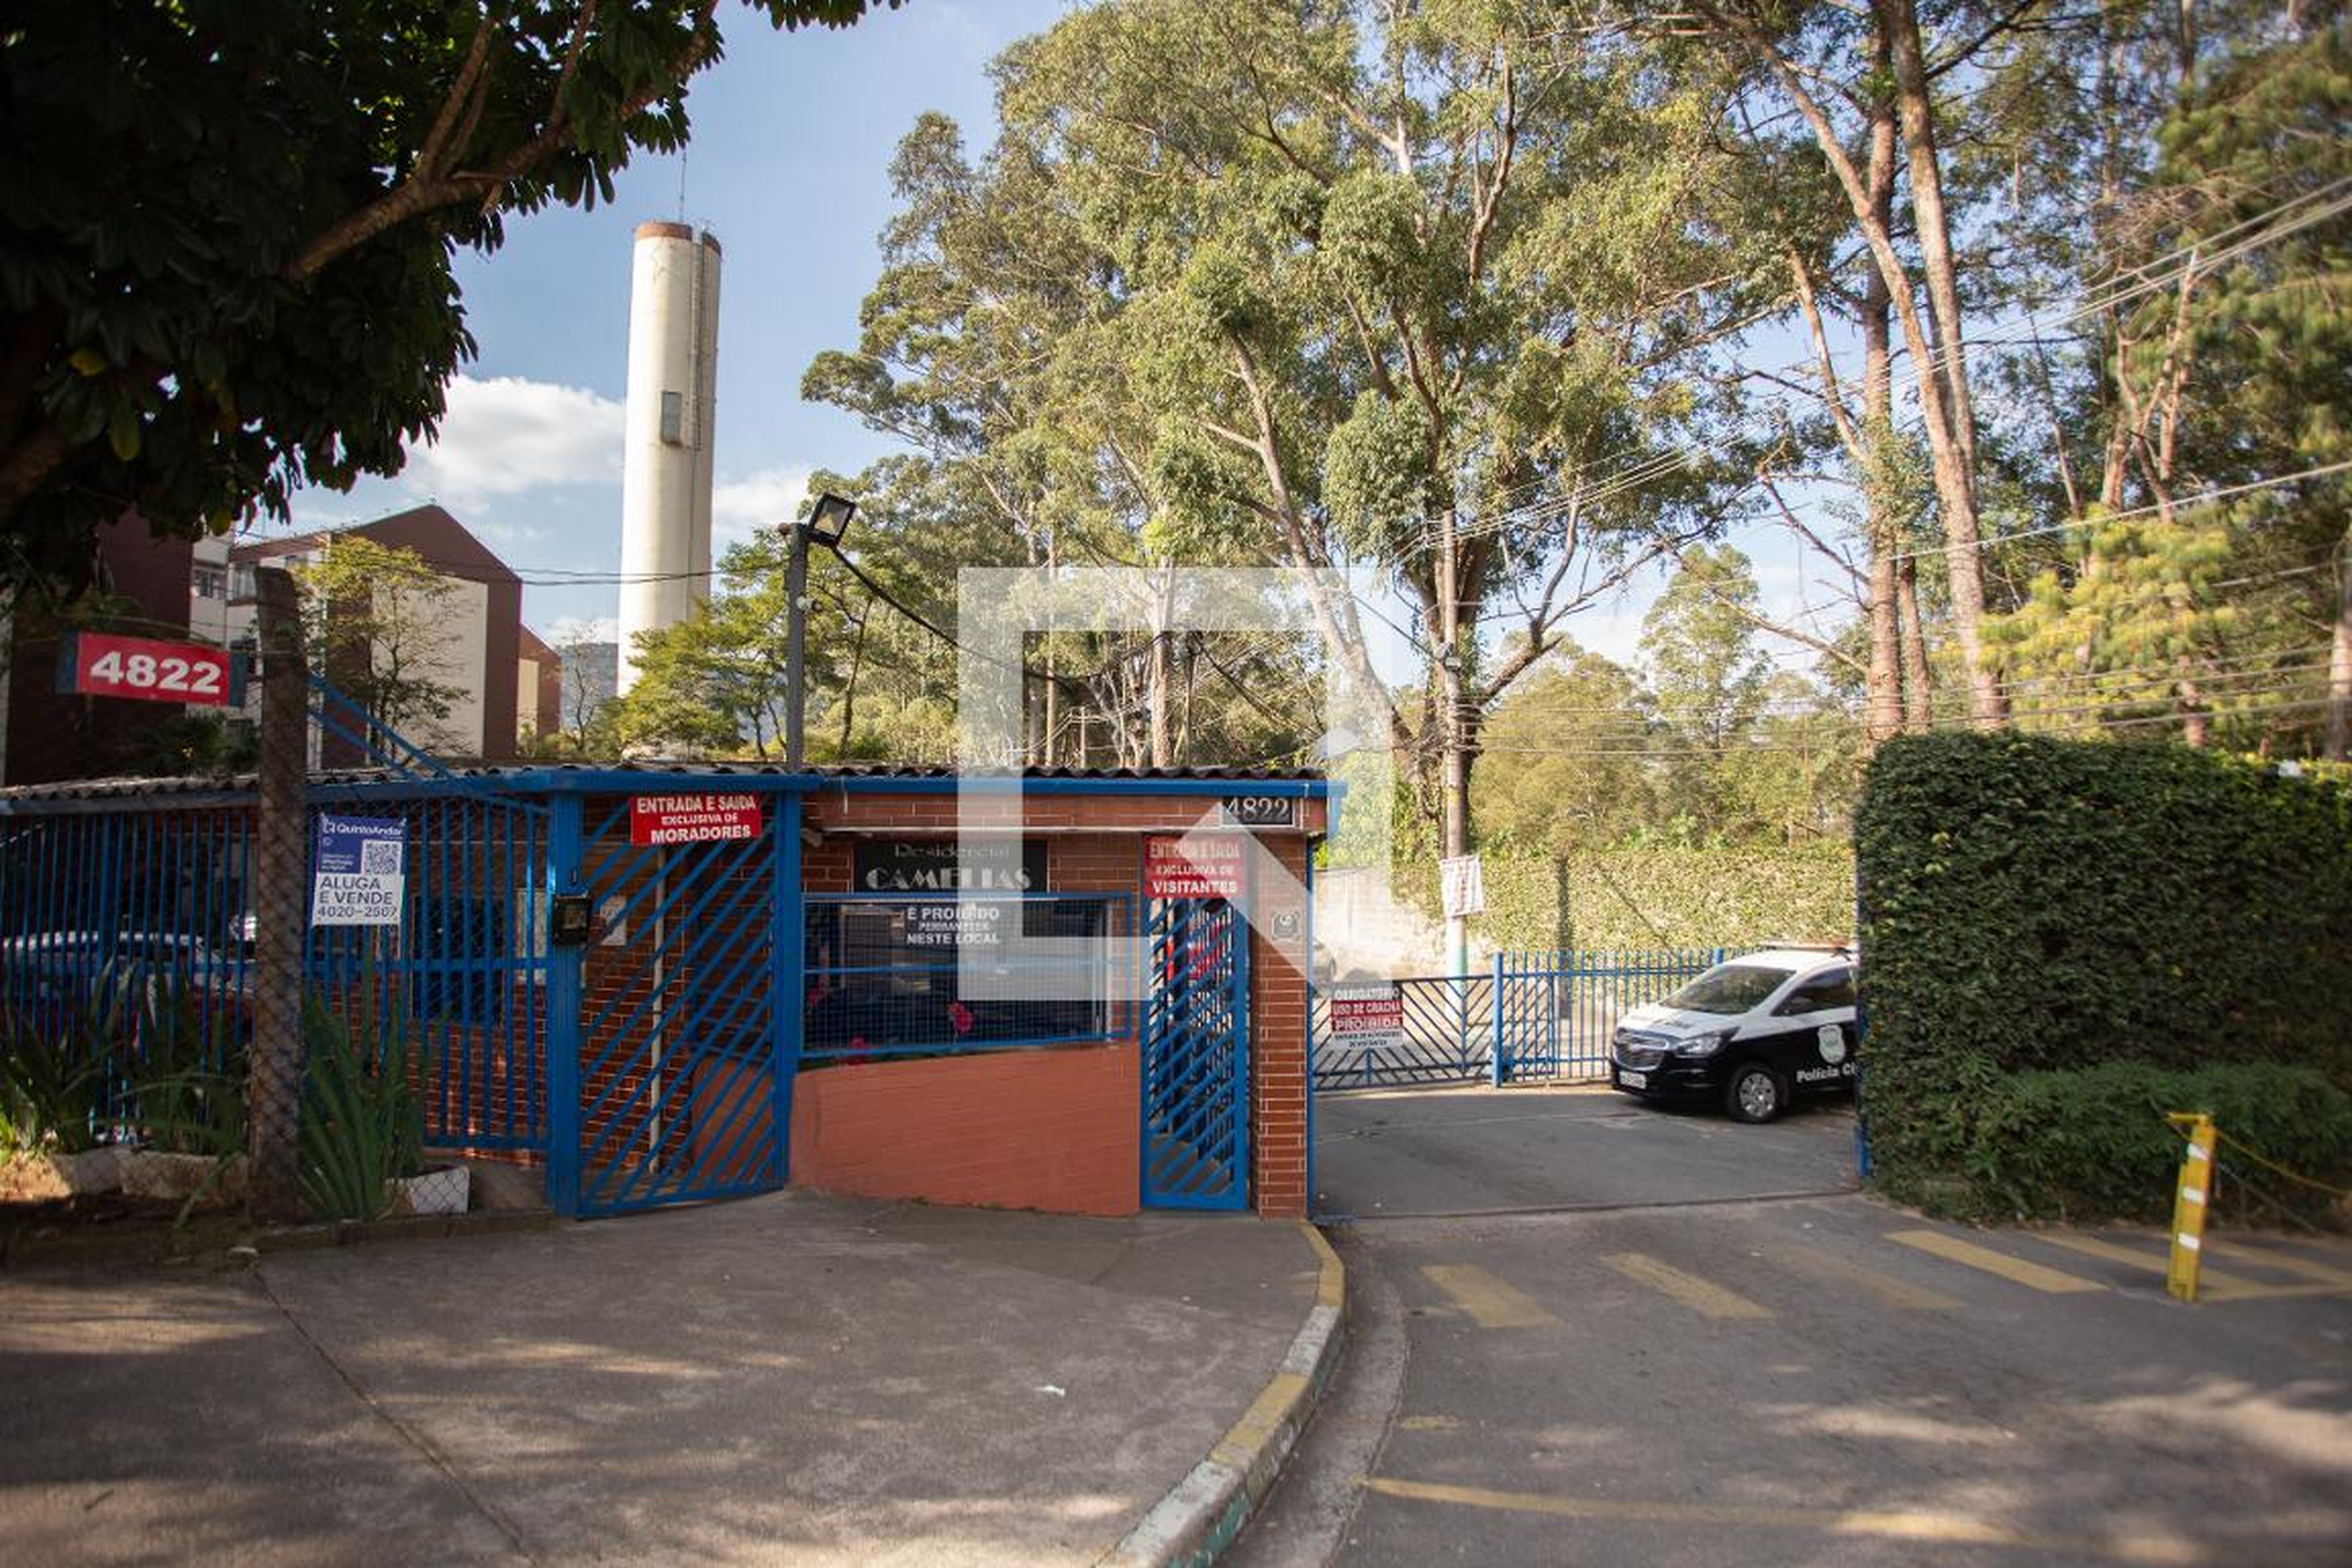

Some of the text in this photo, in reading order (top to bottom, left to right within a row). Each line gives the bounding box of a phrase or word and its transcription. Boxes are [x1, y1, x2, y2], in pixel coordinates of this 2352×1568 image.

[90, 650, 222, 694] 4822
[637, 797, 704, 813] ENTRADA
[706, 796, 715, 811] E
[1226, 797, 1289, 820] 4822
[661, 812, 738, 826] EXCLUSIVA DE
[337, 823, 402, 835] QuintoAndar
[650, 824, 751, 844] MORADORES
[1155, 864, 1217, 875] EXCLUSIVA
[320, 876, 381, 890] ALUGA
[1152, 880, 1238, 894] VISITANTES
[320, 891, 393, 905] E VENDE
[921, 908, 1000, 921] PROIBIDO
[907, 932, 1000, 944] NESTE LOCAL
